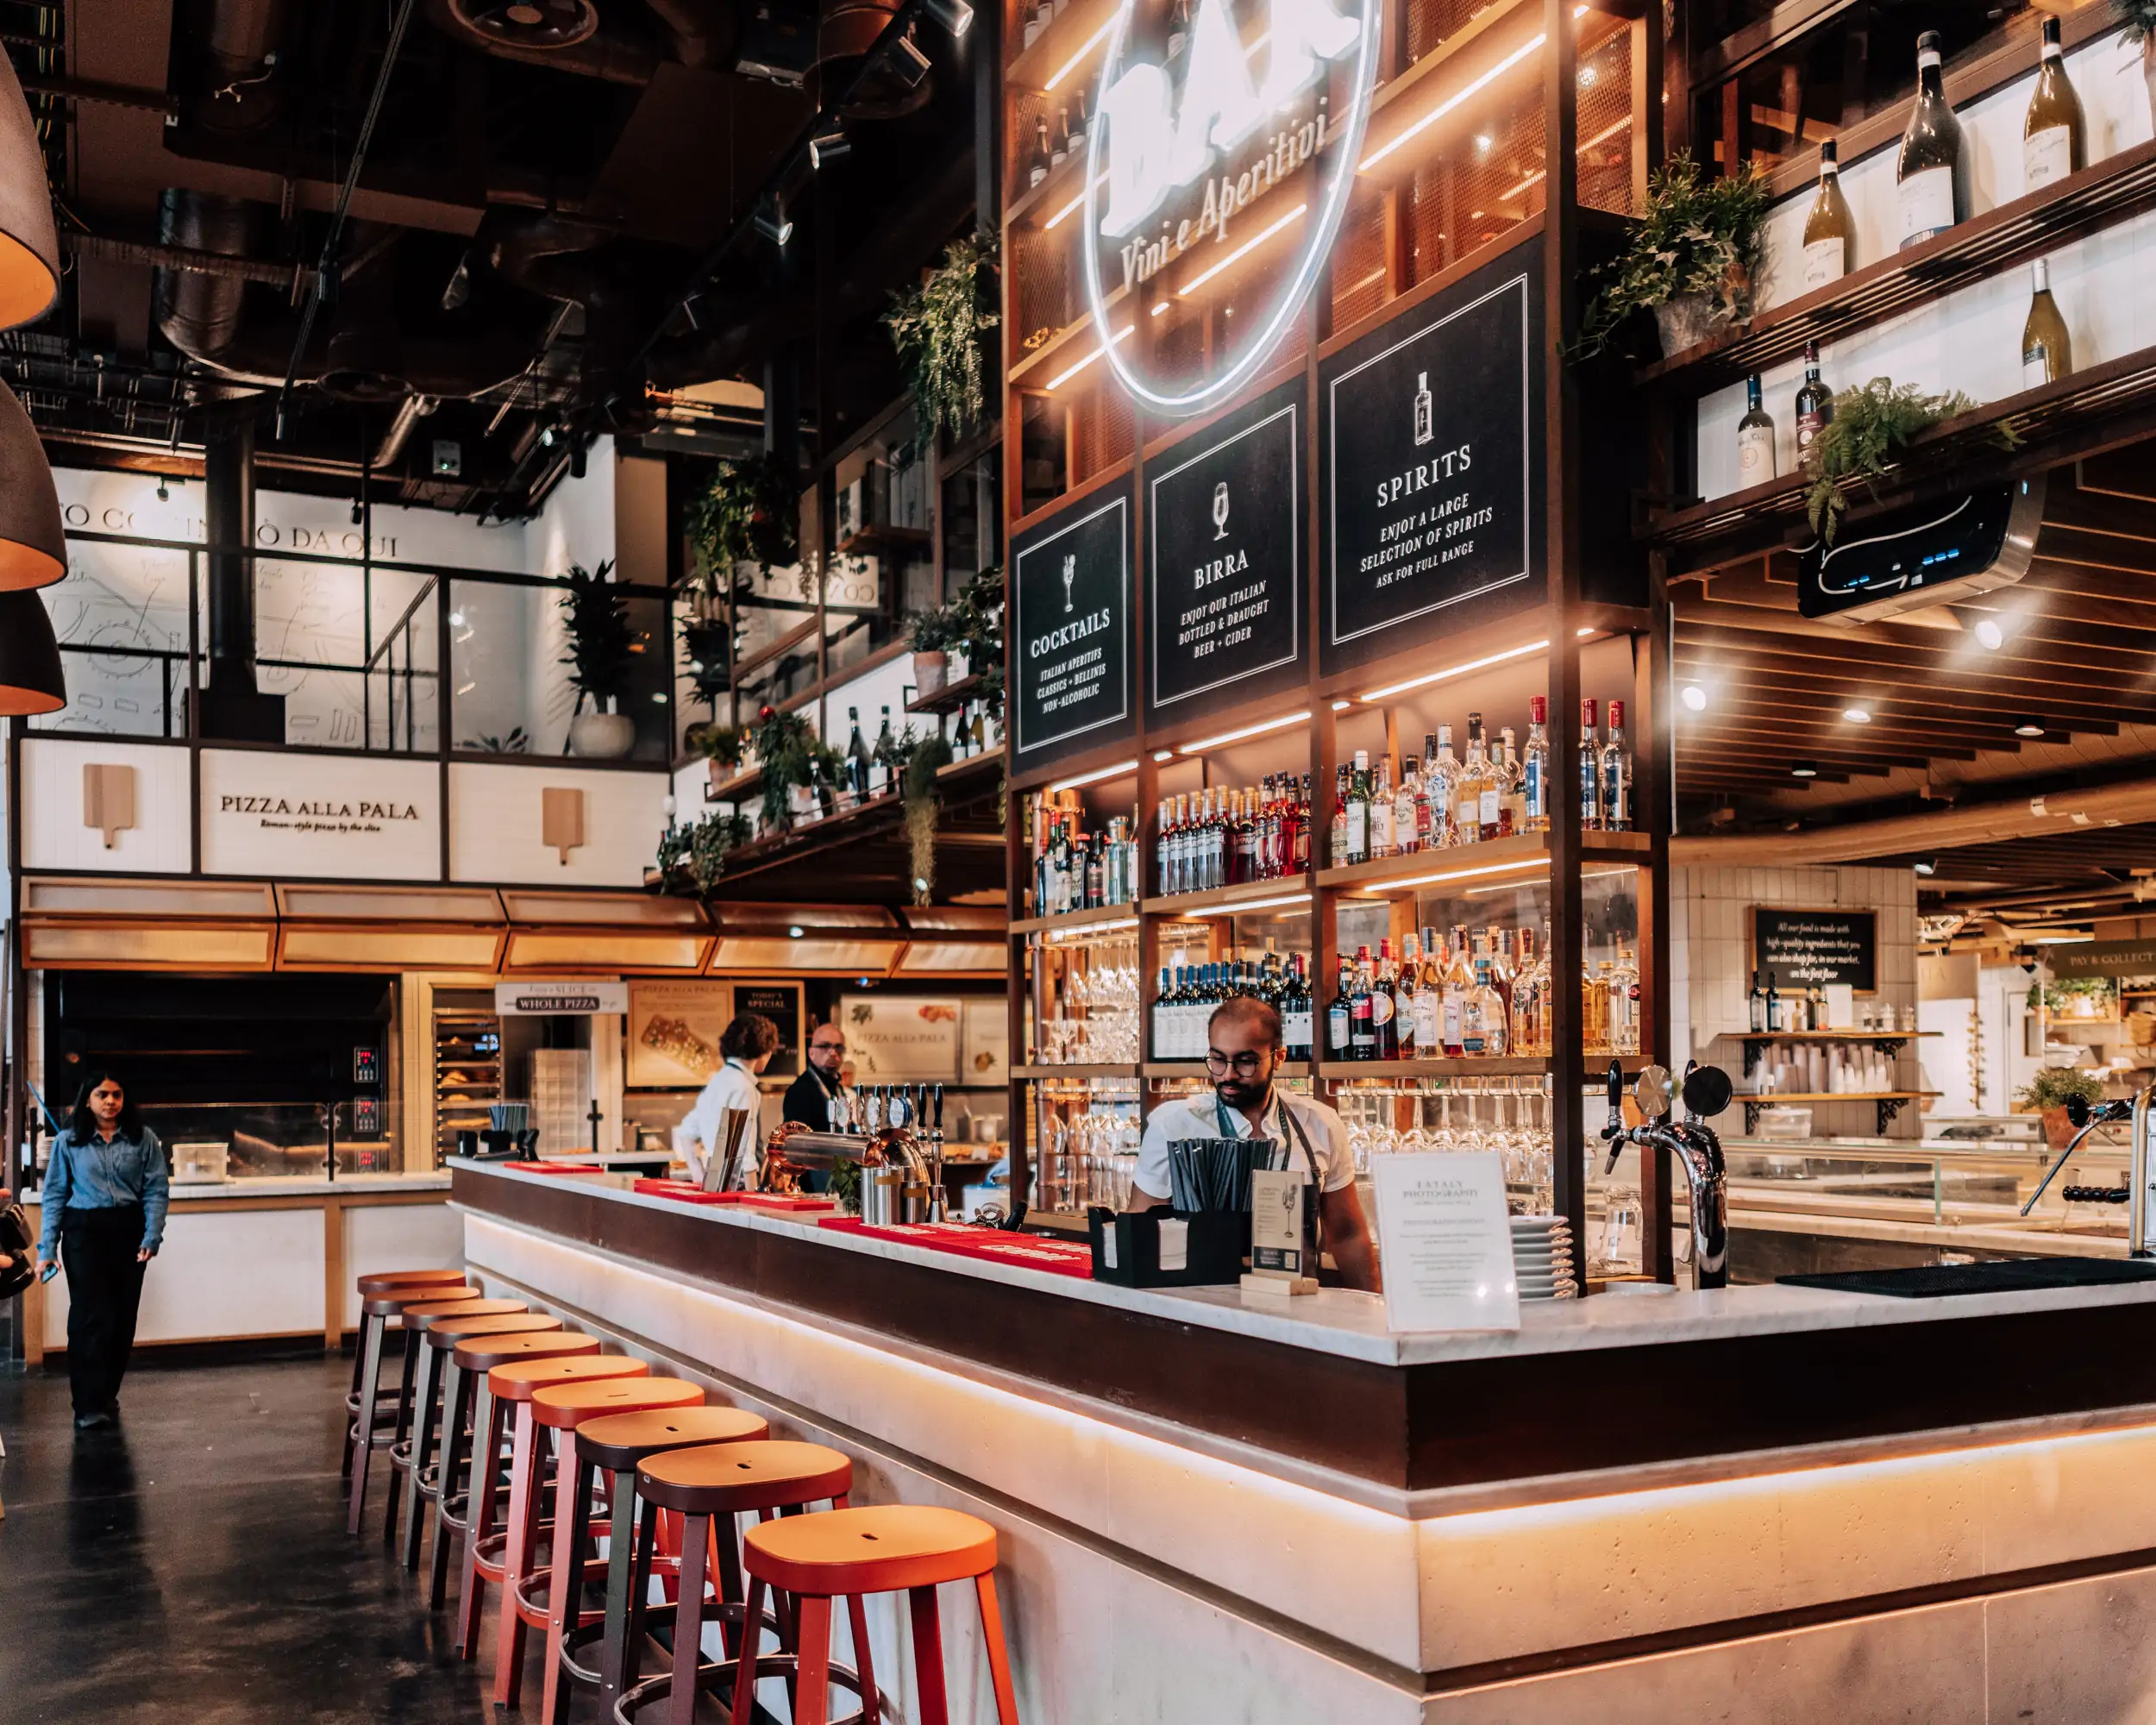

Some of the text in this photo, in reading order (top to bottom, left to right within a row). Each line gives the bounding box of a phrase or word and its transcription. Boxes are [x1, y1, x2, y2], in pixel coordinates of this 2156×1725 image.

[1121, 97, 1329, 293] Vini e Aperitivi
[1377, 444, 1471, 507] SPIRITS
[1381, 493, 1469, 543] ENJOY A LARGE
[291, 526, 330, 551] DA
[1360, 507, 1493, 573] SELECTION OF SPIRITS
[1194, 549, 1249, 590] BIRRA
[1376, 541, 1474, 588] ASK FOR FULL RANGE
[1181, 580, 1267, 626] ENJOY OUR ITALIAN
[1030, 608, 1111, 659] COCKTAILS
[1179, 599, 1269, 645] BOTTLED & DRAUGHT
[1194, 640, 1215, 658] BEER
[1225, 627, 1251, 647] CIDER
[1037, 679, 1068, 700] CLASSICS
[1075, 663, 1106, 686] BELLINIS
[1041, 648, 1102, 682] ITALIAN APERITIFS
[1043, 683, 1100, 714] NON-ALCOHOLIC
[221, 795, 420, 820] PIZZA ALLA PALA
[1798, 922, 1813, 935] food
[1821, 924, 1835, 932] made
[2071, 957, 2087, 967] PAY
[520, 999, 561, 1009] WHOLE
[564, 999, 597, 1009] PIZZA
[748, 1000, 785, 1008] SPECIAL
